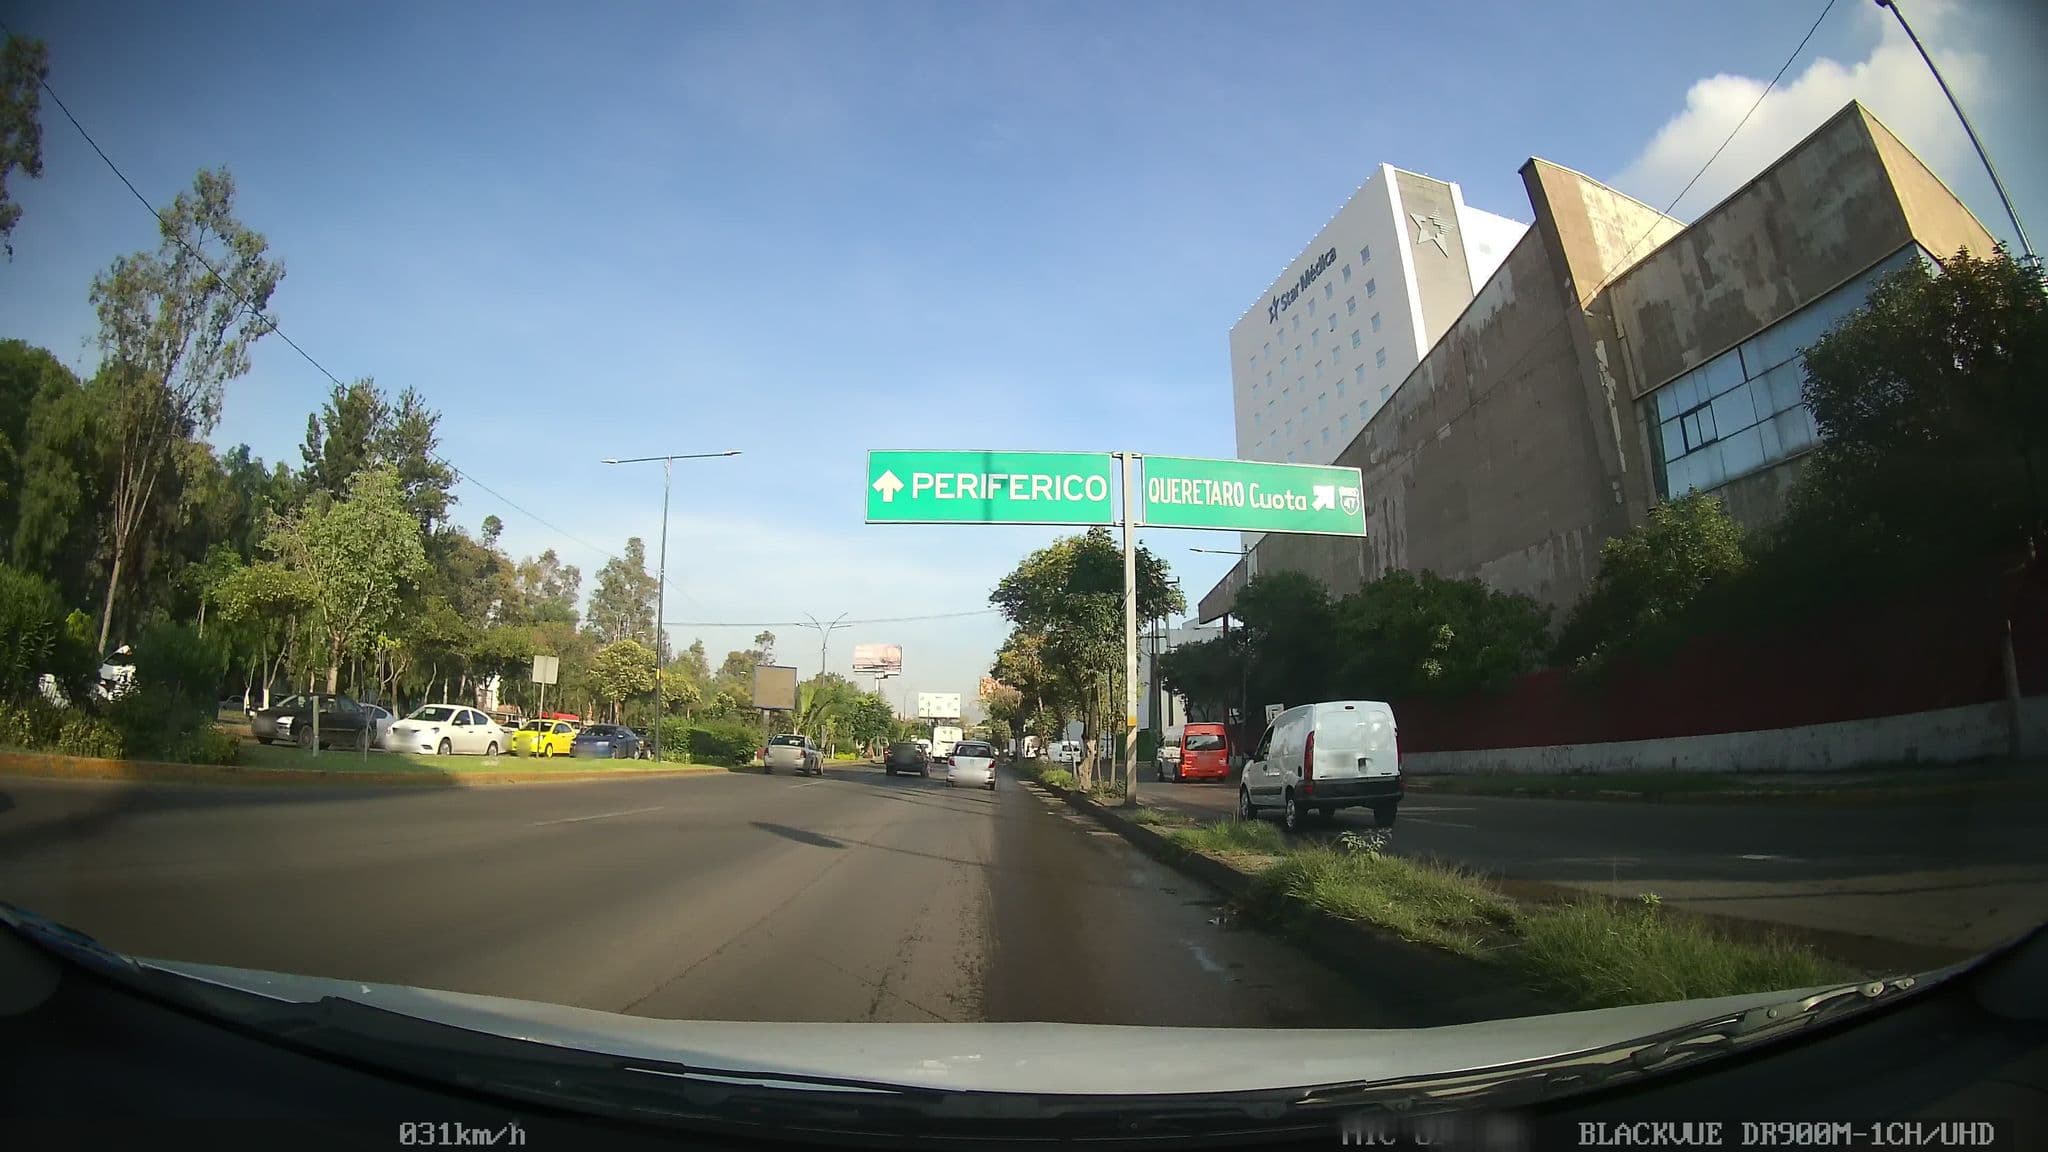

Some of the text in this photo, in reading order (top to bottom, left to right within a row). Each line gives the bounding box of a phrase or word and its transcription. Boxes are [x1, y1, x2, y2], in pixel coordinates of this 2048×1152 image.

[1280, 247, 1337, 312] Star Médica
[911, 472, 1108, 501] PERIFERICO
[1148, 477, 1308, 511] QUERETARO Cuota
